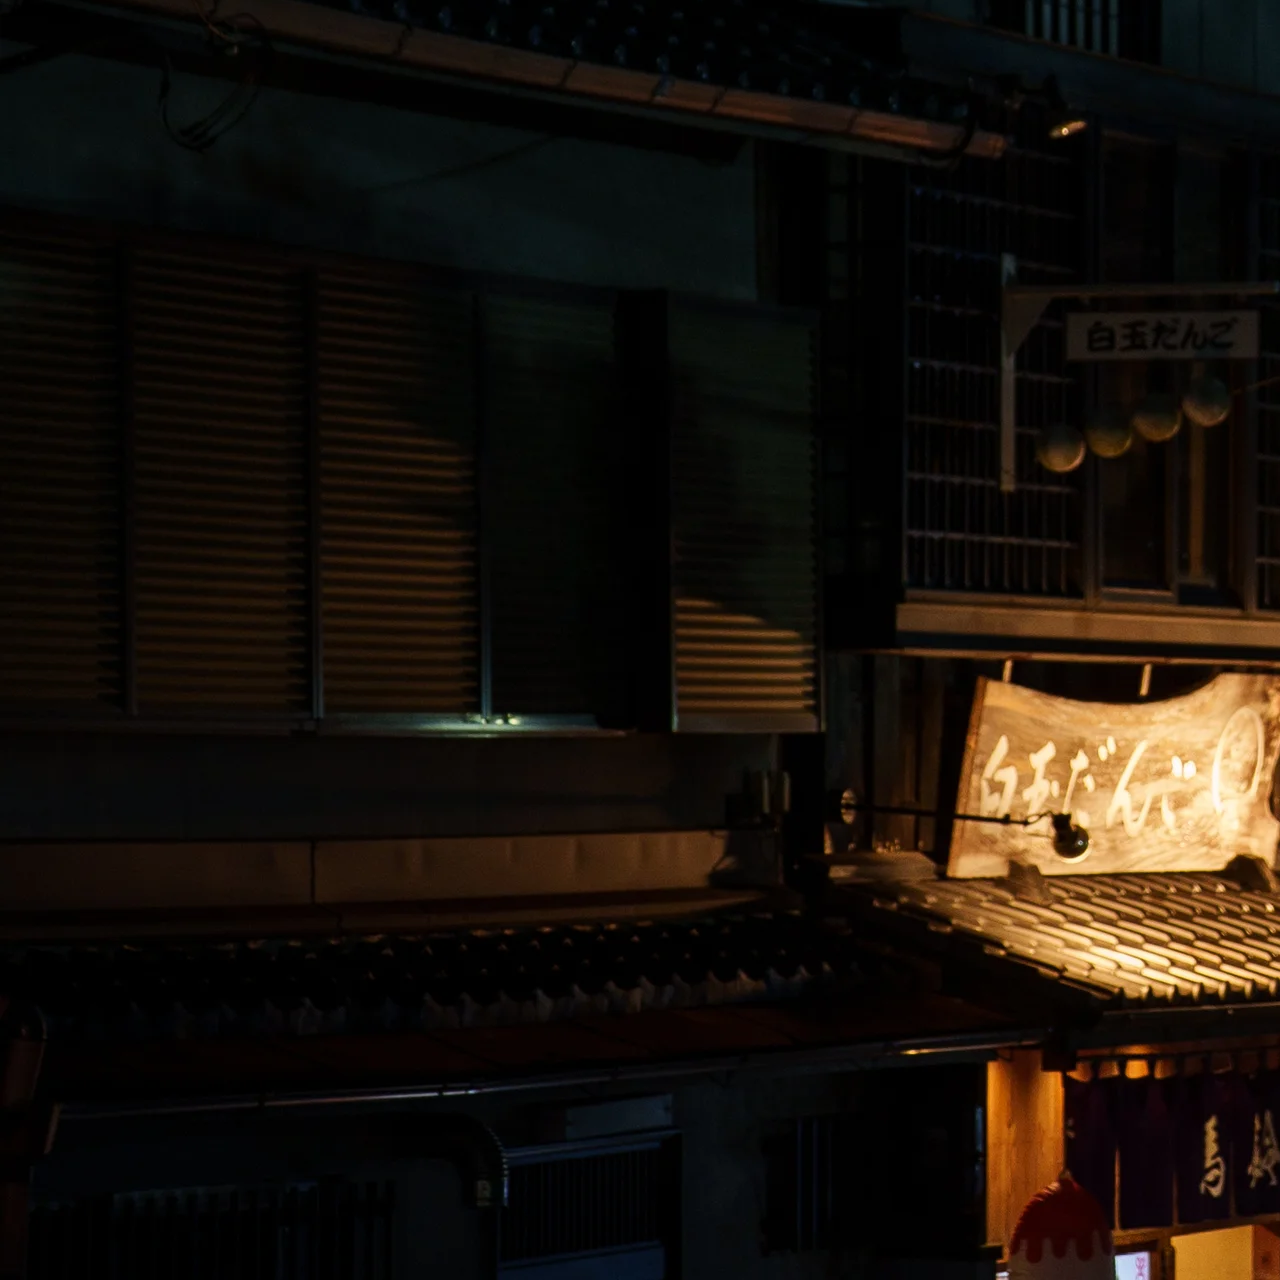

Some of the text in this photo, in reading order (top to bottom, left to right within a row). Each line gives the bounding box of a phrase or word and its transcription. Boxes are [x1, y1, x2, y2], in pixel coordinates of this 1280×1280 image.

[1086, 317, 1238, 352] 白玉だんご
